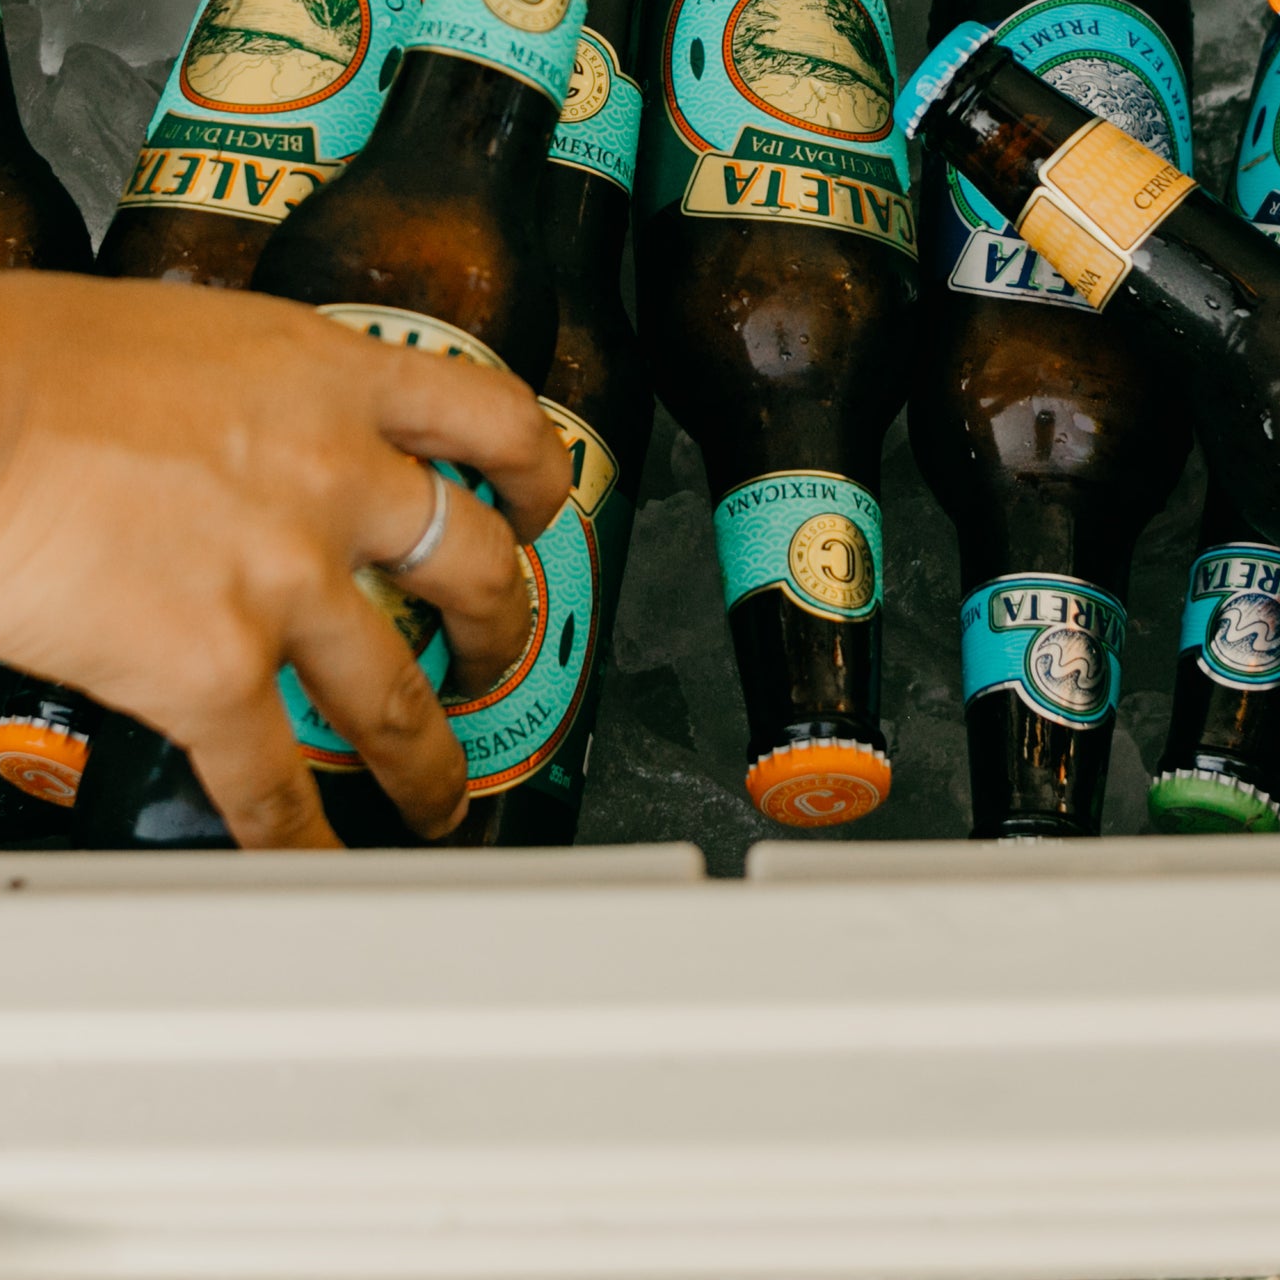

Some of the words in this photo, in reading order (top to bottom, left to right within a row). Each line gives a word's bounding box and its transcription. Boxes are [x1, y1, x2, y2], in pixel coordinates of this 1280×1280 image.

[1127, 30, 1191, 144] CERVEZA
[225, 128, 304, 152] BEACH
[551, 133, 634, 180] MEXICAN
[752, 136, 785, 157] IPA
[790, 145, 837, 166] DAY
[723, 162, 916, 246] CALETA
[725, 482, 838, 518] MEXICANA
[798, 519, 837, 548] COSTA
[465, 699, 553, 762] ESANAL
